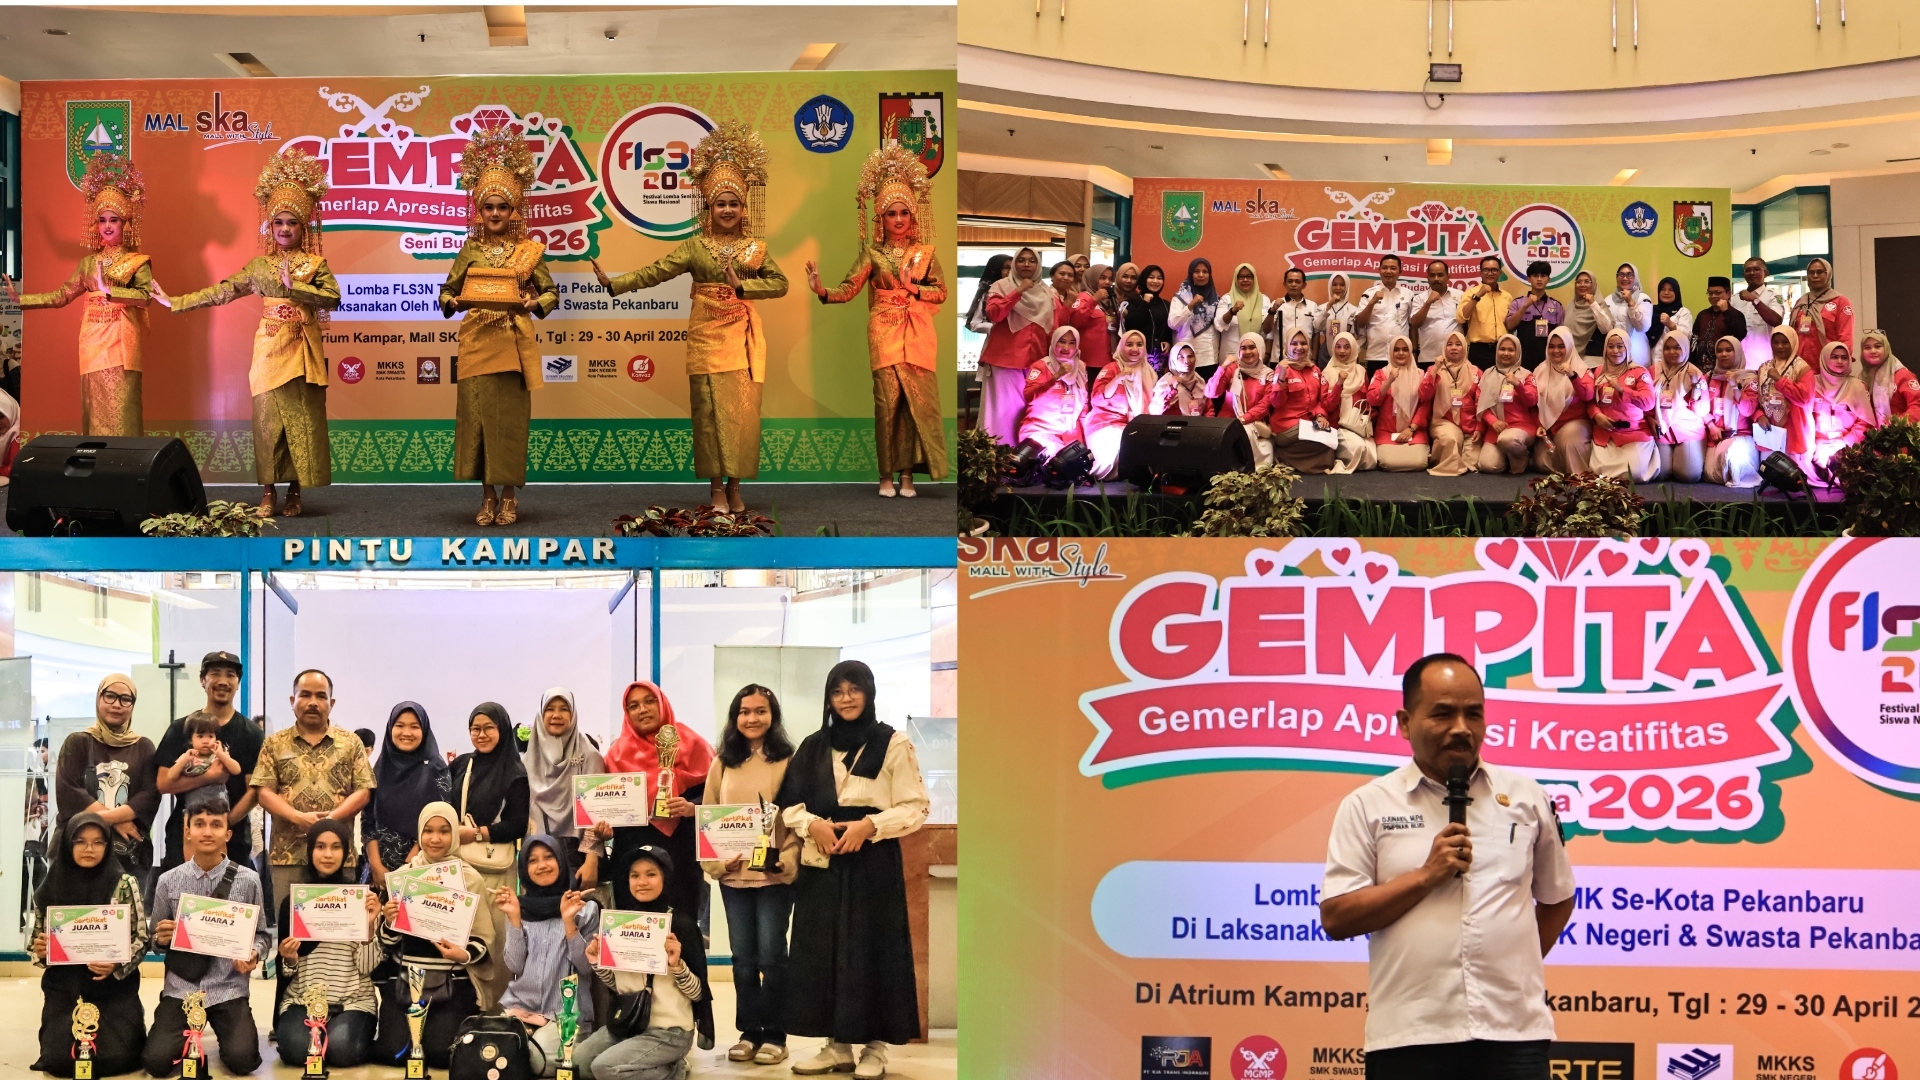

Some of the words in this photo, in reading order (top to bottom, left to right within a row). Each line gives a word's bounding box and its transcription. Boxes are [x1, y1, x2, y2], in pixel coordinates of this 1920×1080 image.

[144, 113, 189, 131] MAL
[196, 92, 248, 132] ska
[247, 122, 273, 144] Style
[643, 172, 694, 189] 202
[318, 197, 380, 214] merlap
[1212, 201, 1241, 212] MAL
[1246, 188, 1279, 213] ska
[404, 237, 437, 250] Seni
[526, 229, 585, 251] 026
[1298, 220, 1491, 253] GEMPITA
[1527, 246, 1570, 258] 2026
[1303, 257, 1361, 268] Gemerlap
[1364, 258, 1420, 272] Apiasi
[347, 284, 389, 295] Lomba
[393, 284, 433, 295] FLS3N
[335, 301, 397, 311] ksanakan
[400, 301, 429, 311] Oleh
[564, 299, 608, 310] Swasta
[612, 299, 679, 310] Pekanbaru
[321, 333, 349, 343] rium
[353, 332, 406, 345] Kampar,
[410, 332, 435, 342] Mall
[439, 332, 460, 342] SK
[546, 331, 567, 344] Tgl
[578, 331, 594, 342] 29
[606, 331, 620, 342] 30
[624, 331, 655, 344] April
[658, 331, 688, 342] 2026
[377, 361, 405, 369] MKKS
[284, 539, 412, 561] PINTU
[442, 538, 616, 561] KAMPAR
[969, 566, 1009, 576] MALL
[1015, 566, 1051, 576] WITH
[1051, 543, 1109, 586] Style
[1119, 579, 1757, 681] GEMPITA
[1880, 703, 1920, 713] Festival
[1138, 700, 1324, 738] Gemerlap
[1530, 719, 1729, 753] Kreatifitas
[1880, 715, 1910, 725] Siswa
[1589, 774, 1753, 820] 2026
[425, 893, 455, 905] Sertifikat
[1254, 883, 1320, 906] Lomb
[1612, 887, 1714, 912] Se-Kota
[1723, 889, 1864, 914] Pekanbaru
[203, 908, 235, 919] Sertifikat
[421, 899, 448, 911] JUARA
[200, 916, 228, 925] JUARA
[622, 923, 650, 931] Sertifikat
[1172, 917, 1197, 940] Di
[1586, 922, 1670, 952] Negeri
[1678, 925, 1698, 947] &
[1706, 924, 1801, 949] Swasta
[1810, 926, 1920, 950] Pekanba
[1136, 983, 1161, 1004] Di
[1169, 983, 1255, 1006] Atrium
[1264, 985, 1369, 1013] Kampar,
[1544, 990, 1659, 1017] kanbaru,
[1668, 991, 1710, 1020] Tgl
[1736, 993, 1768, 1016] 29
[1794, 994, 1826, 1017] 30
[1833, 995, 1898, 1022] April
[1162, 1050, 1203, 1067] RJA
[1313, 1047, 1366, 1064] MKKS
[1757, 1055, 1815, 1072] MKKS
[1244, 1070, 1274, 1078] MGMP
[1310, 1067, 1330, 1075] SMK
[1332, 1067, 1366, 1076] SWAST
